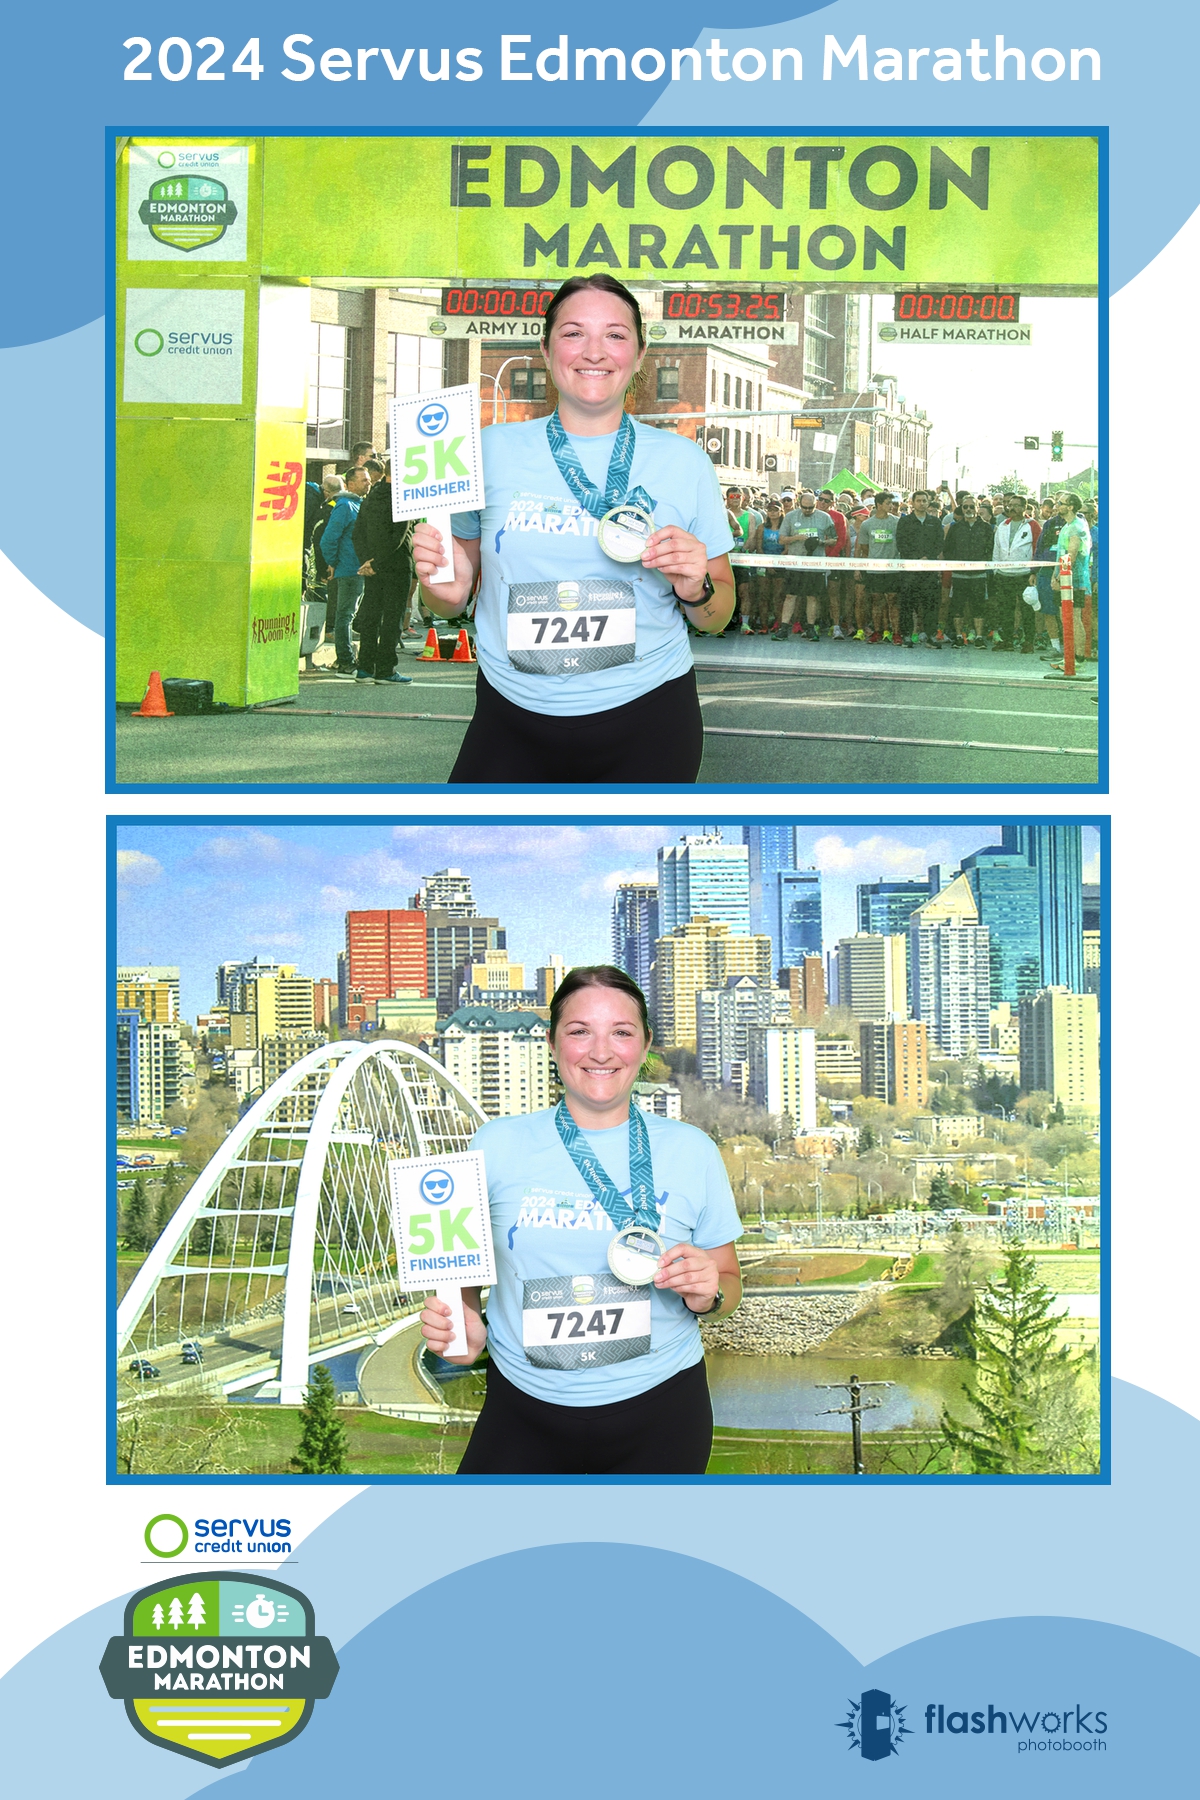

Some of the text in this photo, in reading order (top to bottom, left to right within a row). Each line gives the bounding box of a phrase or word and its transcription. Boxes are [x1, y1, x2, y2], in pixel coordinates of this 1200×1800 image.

[178, 152, 220, 161] servus
[450, 144, 989, 211] EDMONTON
[149, 203, 227, 214] EDMONTON
[160, 214, 215, 222] MARATHON
[523, 222, 906, 271] MARATHON
[466, 321, 517, 335] ARMY
[679, 325, 785, 340] MARATHON
[900, 328, 1030, 340] HALF MARATHON
[168, 332, 233, 345] servus
[168, 345, 233, 355] credit union
[402, 435, 471, 485] 5K
[403, 480, 470, 501] FINISHER!
[509, 500, 544, 512] 2024
[532, 615, 609, 644] 7247
[563, 657, 579, 667] 5K
[520, 1196, 556, 1208] 2024
[408, 1207, 480, 1255] 5K
[410, 1254, 481, 1271] FINISHER!
[547, 1308, 624, 1339] 7247
[581, 1351, 596, 1361] 5K
